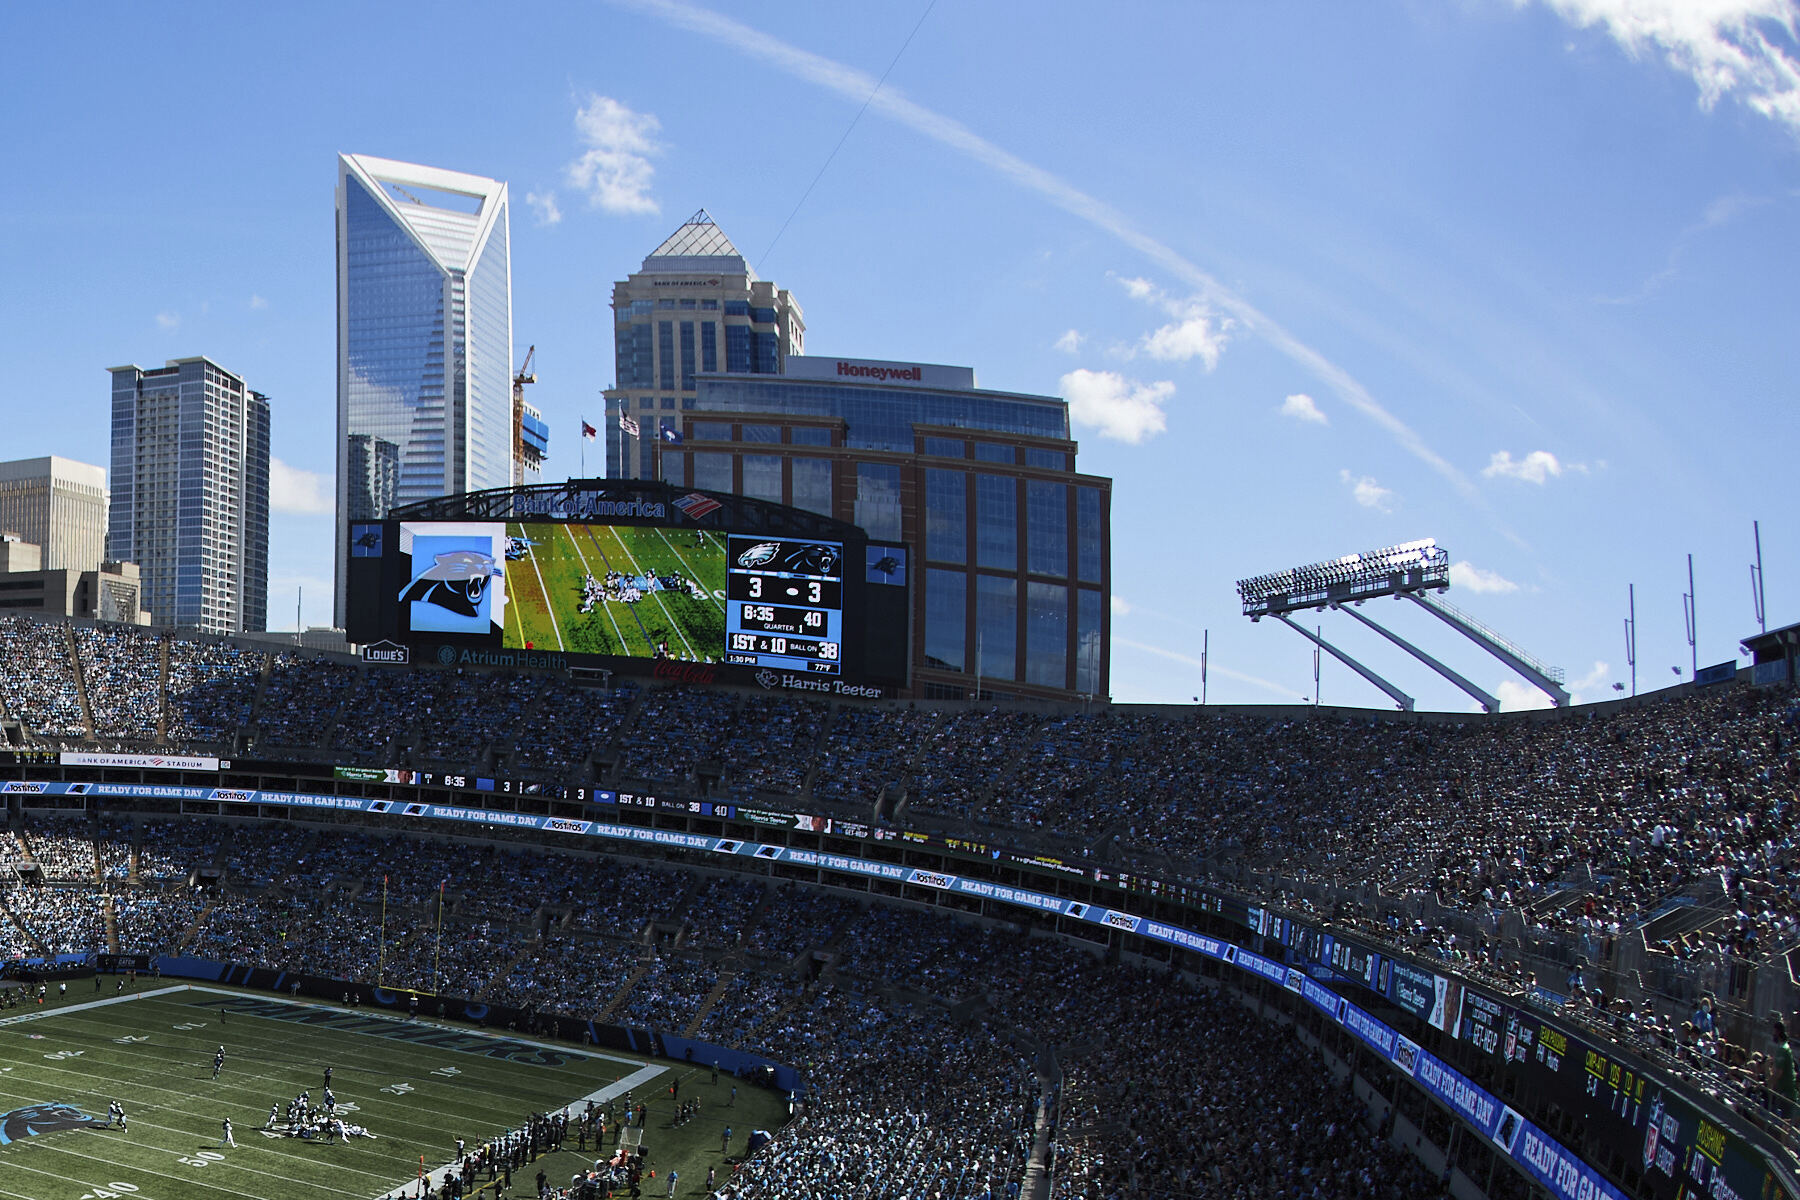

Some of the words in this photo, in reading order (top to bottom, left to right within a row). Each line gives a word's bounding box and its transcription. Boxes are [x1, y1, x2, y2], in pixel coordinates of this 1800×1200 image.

[837, 362, 921, 381] Honeywell
[513, 495, 561, 513] Bank
[563, 498, 582, 514] of
[584, 497, 666, 517] America
[749, 577, 762, 598] 3
[808, 582, 821, 603] 3
[763, 623, 795, 632] QUARTER
[798, 625, 803, 634] 1
[803, 612, 822, 627] 40
[366, 648, 405, 662] LOWE'S
[732, 634, 757, 651] 1ST
[760, 641, 768, 650] &
[770, 638, 787, 654] 10
[789, 643, 806, 651] BALL
[807, 645, 817, 653] ON
[818, 642, 838, 660] 38
[460, 649, 514, 668] Atrium
[518, 653, 567, 670] Health
[729, 655, 744, 664] 1:30
[744, 657, 756, 665] PM
[781, 674, 831, 693] Harris
[833, 680, 882, 699] Teeter
[112, 758, 147, 766] AMERICA
[98, 785, 130, 794] READY
[132, 786, 152, 795] FOR
[153, 787, 181, 796] GAME
[183, 788, 202, 797] DAY
[444, 775, 465, 788] 6:35
[503, 782, 510, 792] 3
[577, 788, 585, 800] 3
[619, 793, 633, 805] 1ST
[636, 796, 643, 805] &
[645, 796, 655, 807] 10
[661, 801, 674, 809] BALL
[688, 802, 700, 813] 38
[714, 805, 727, 817] 40
[597, 825, 631, 838] READY
[632, 829, 653, 840] FOR
[655, 832, 684, 844] GAME
[686, 836, 707, 847] DAY
[789, 850, 826, 865] READY
[829, 856, 848, 869] FOR
[850, 860, 879, 874] GAME
[881, 864, 902, 877] DAY
[961, 879, 994, 896] READY
[996, 886, 1013, 900] FOR
[1014, 890, 1042, 906] GAME
[1043, 896, 1061, 910] DAY
[1697, 1119, 1727, 1160] RUSHING
[178, 1151, 225, 1169] 50
[1523, 1132, 1558, 1182] READY
[1555, 1157, 1578, 1199] FOR
[1690, 1150, 1705, 1186] ATL
[92, 1181, 141, 1200] 40
